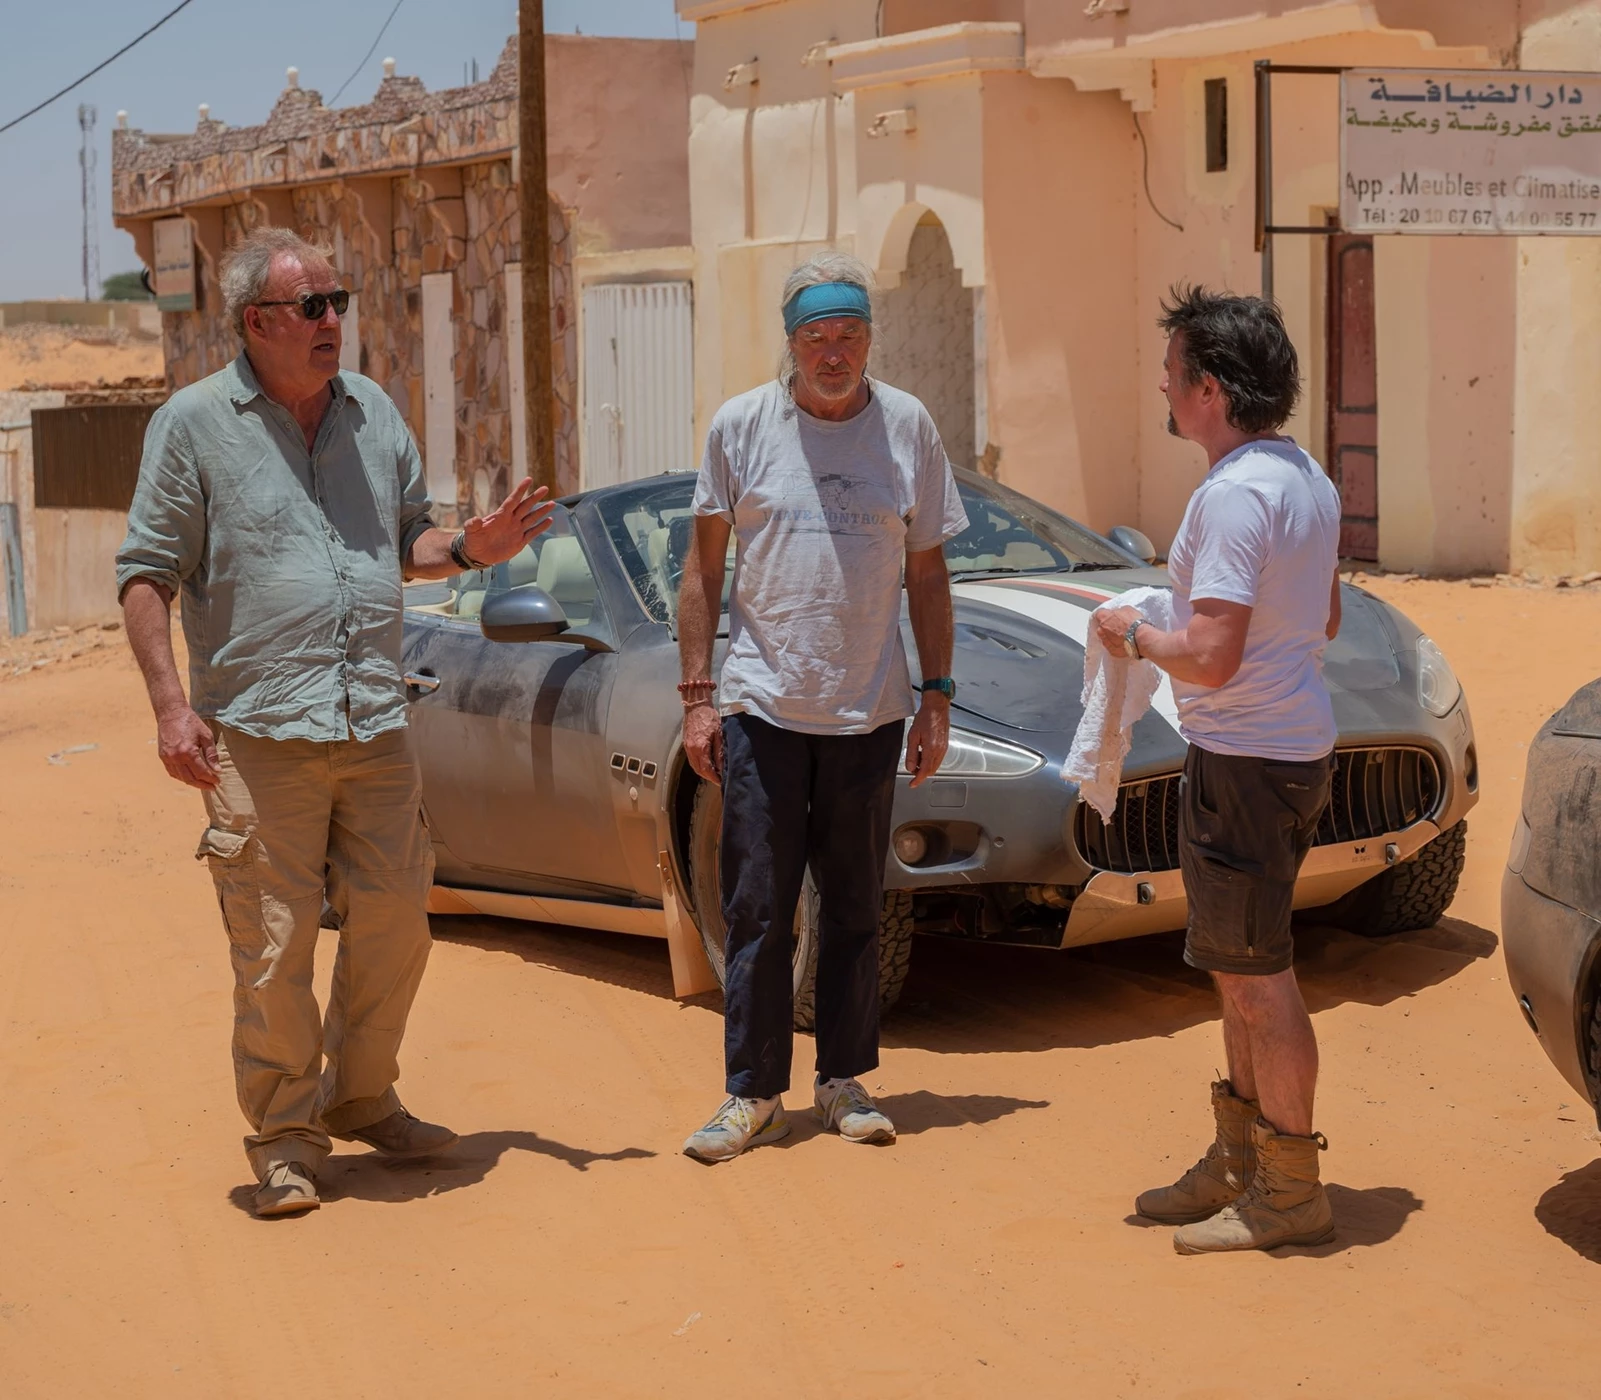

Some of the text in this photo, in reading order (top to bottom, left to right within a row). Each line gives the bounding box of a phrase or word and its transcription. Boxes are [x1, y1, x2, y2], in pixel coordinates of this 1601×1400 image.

[1368, 77, 1583, 109] دار الضيافة
[1446, 111, 1552, 137] مفروشة
[1400, 172, 1483, 197] Meubles
[1487, 180, 1507, 198] et
[1399, 208, 1420, 223] 20
[1448, 209, 1468, 225] 67
[1472, 210, 1492, 226] 67
[1578, 212, 1597, 228] 77
[818, 509, 889, 526] CONTROL
